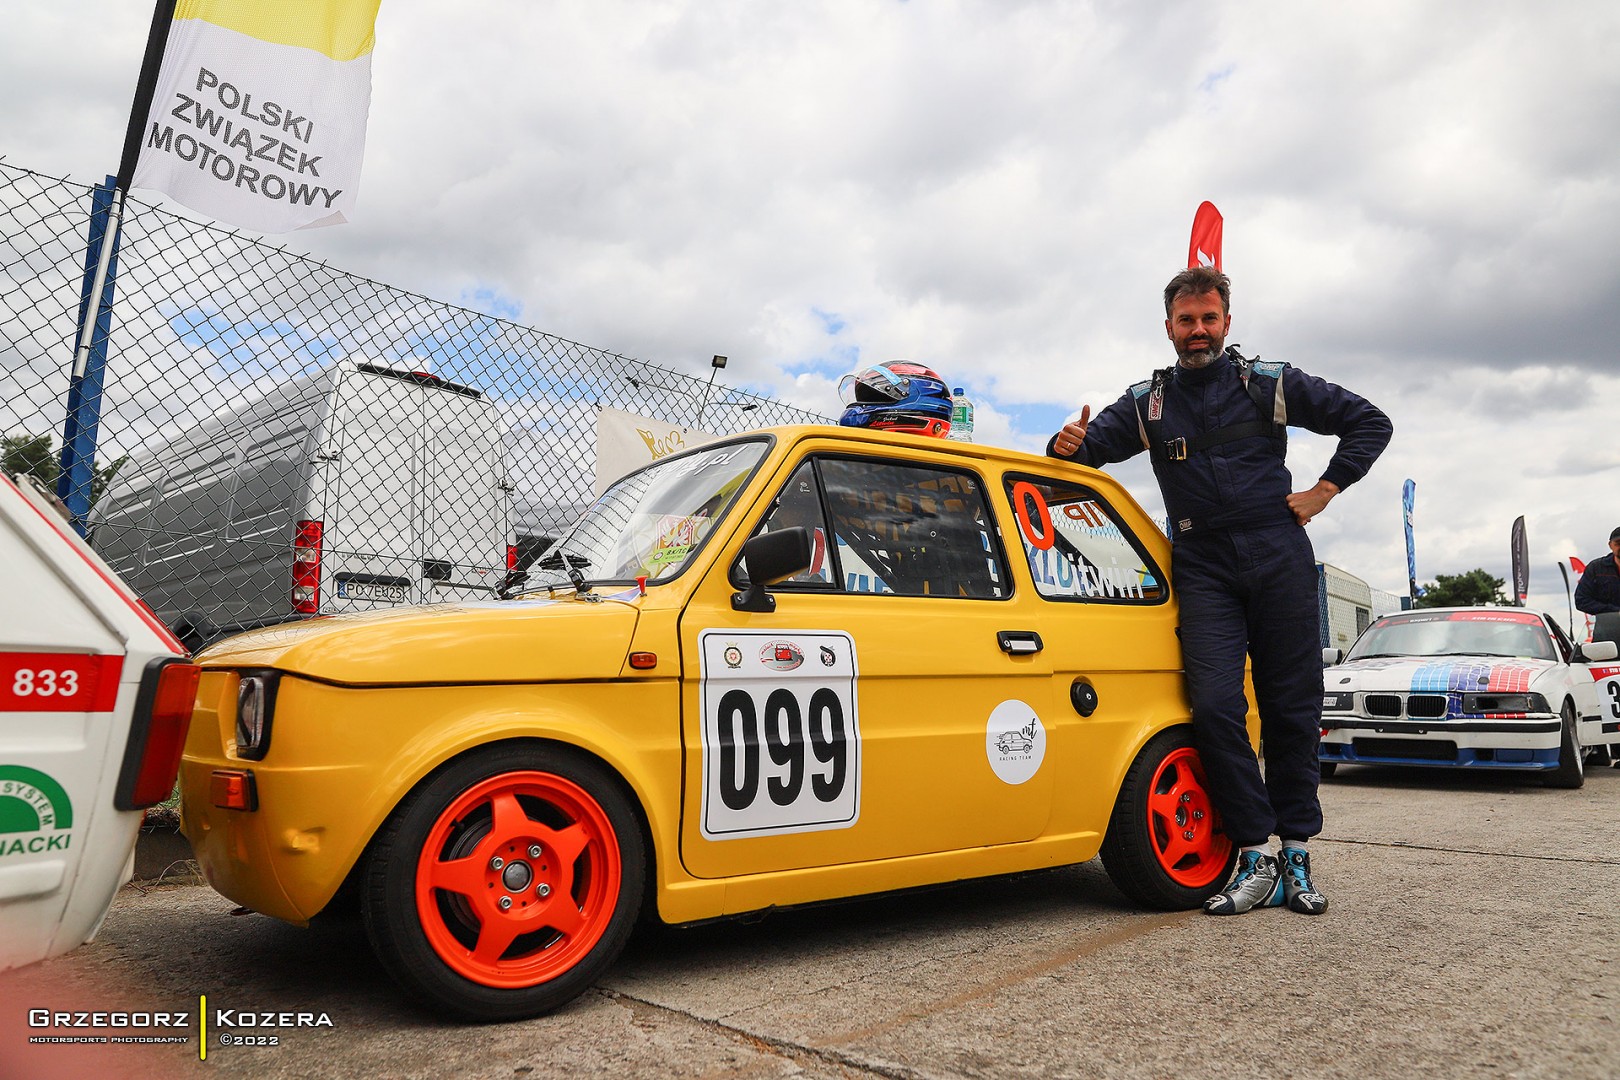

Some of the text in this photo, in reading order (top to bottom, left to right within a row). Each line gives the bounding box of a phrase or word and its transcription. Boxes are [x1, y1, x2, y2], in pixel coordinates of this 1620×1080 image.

[172, 93, 323, 178] ZWIĄZEK
[196, 67, 314, 144] POLSKI
[147, 122, 343, 209] MOTOROWY
[12, 668, 79, 697] 833
[717, 688, 847, 811] 099
[3, 782, 53, 826] SYSTEM
